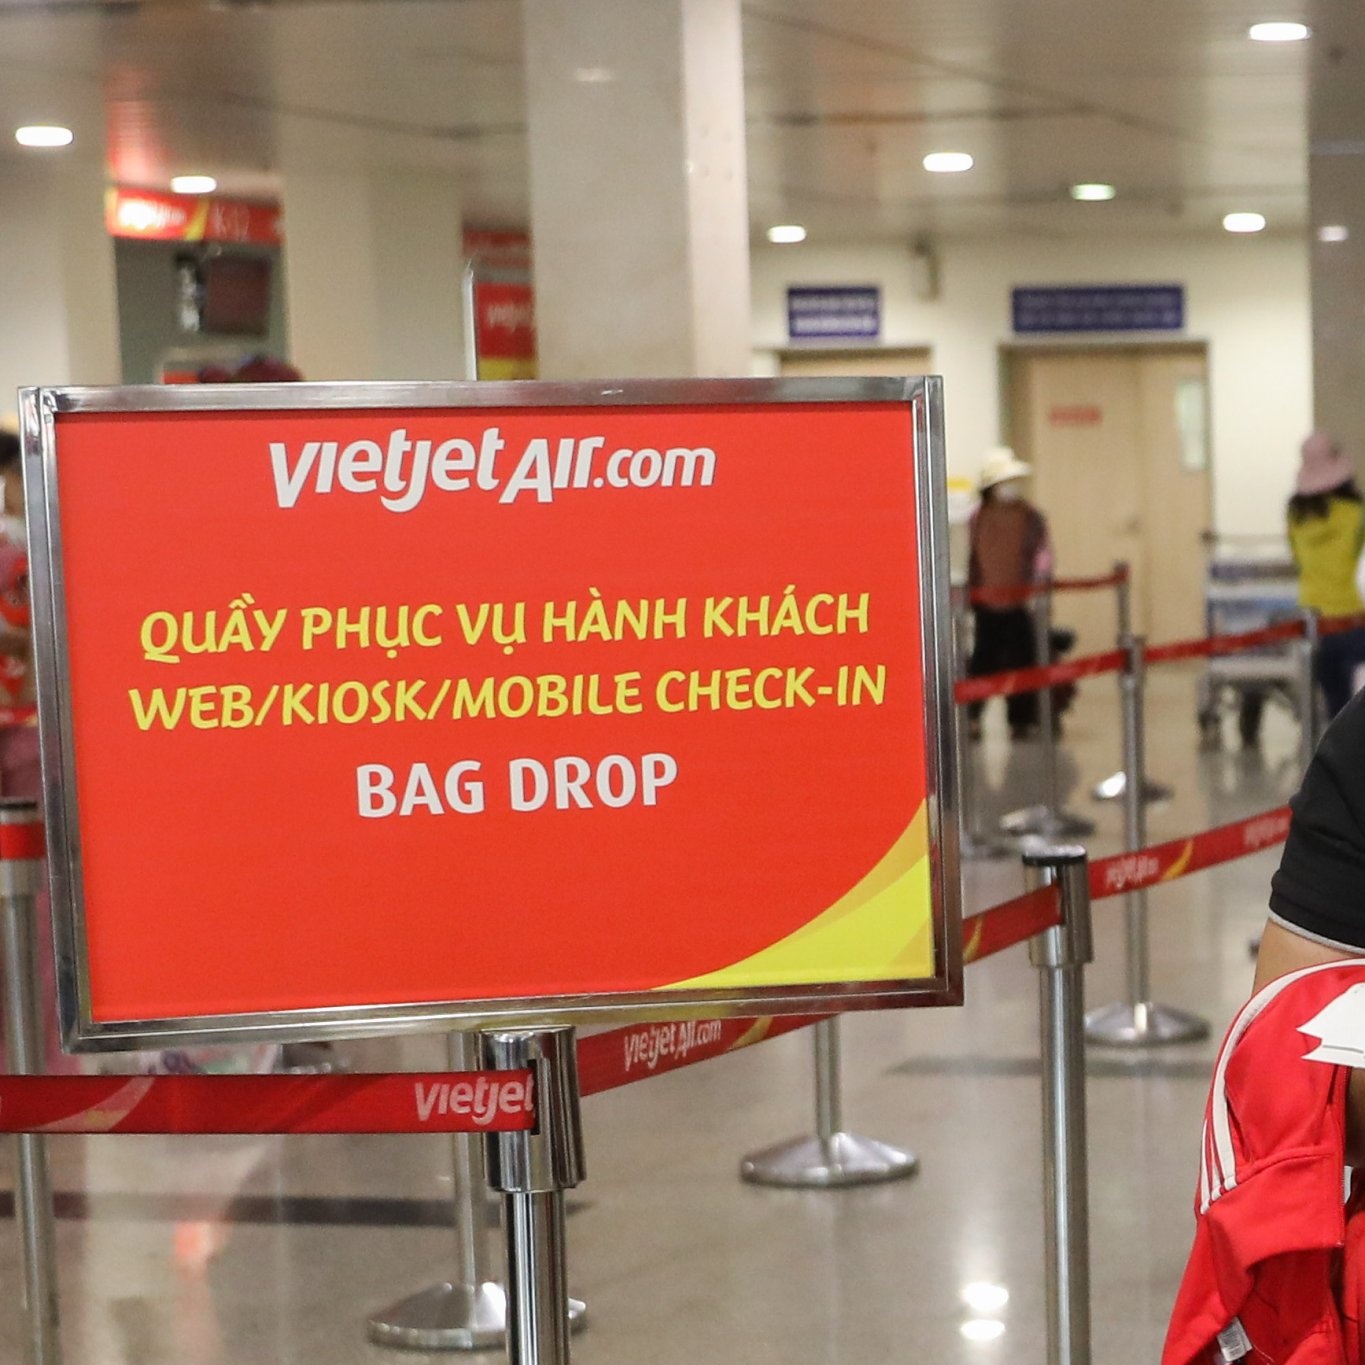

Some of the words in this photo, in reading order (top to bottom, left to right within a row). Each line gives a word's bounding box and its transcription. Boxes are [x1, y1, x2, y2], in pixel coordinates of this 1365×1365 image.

[141, 593, 287, 664] QUẦY
[301, 604, 443, 659] PHỤC
[456, 602, 527, 655] VỤ
[543, 588, 687, 643] HÀNH
[704, 584, 869, 638] KHÁCH
[129, 672, 642, 730] WEB/KIOSK/MOBILE
[656, 664, 886, 712] CHECK-IN
[357, 760, 484, 818] BAG
[510, 753, 677, 812] DROP
[414, 1075, 535, 1125] Vietjet
